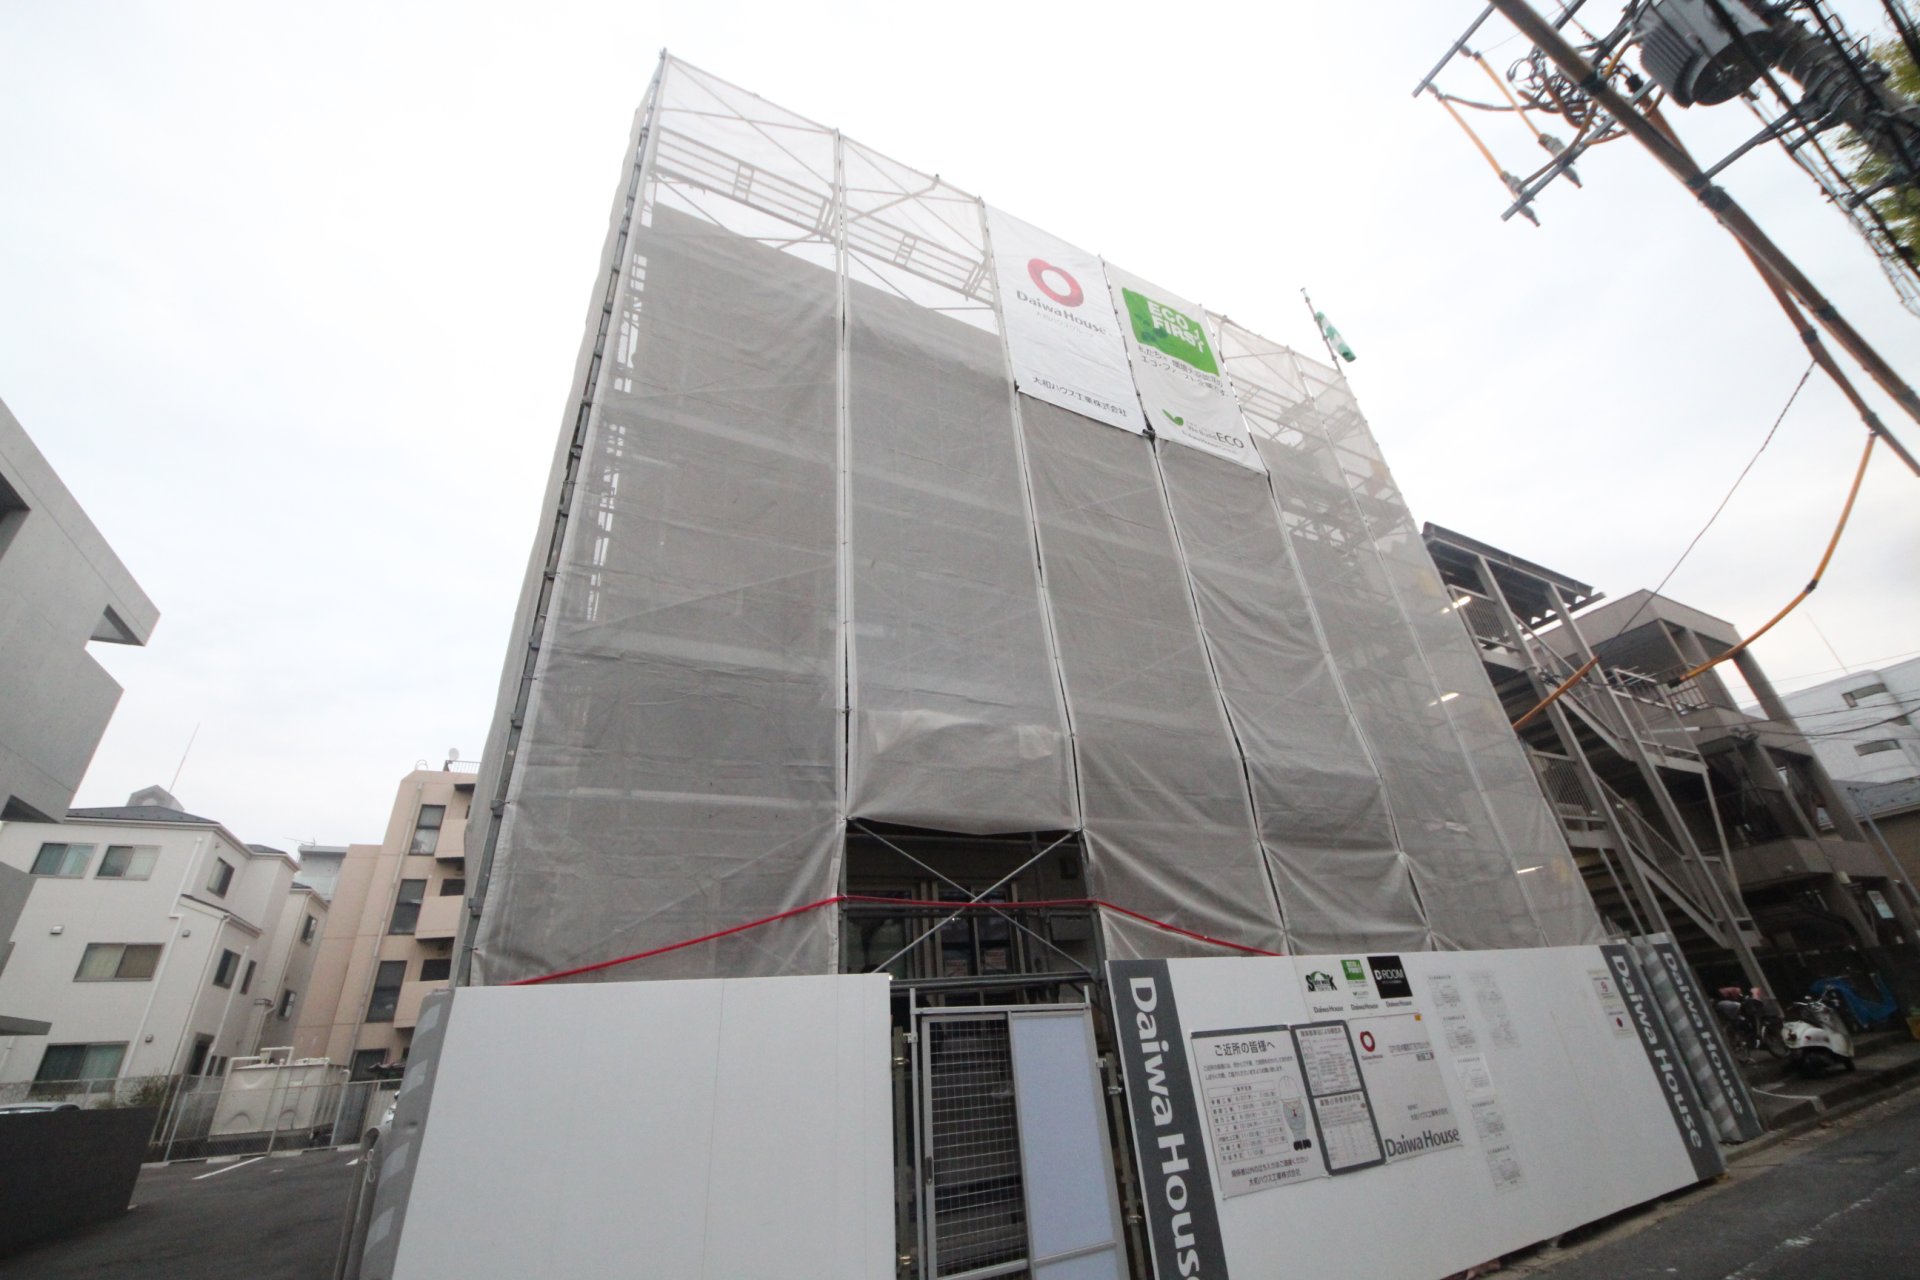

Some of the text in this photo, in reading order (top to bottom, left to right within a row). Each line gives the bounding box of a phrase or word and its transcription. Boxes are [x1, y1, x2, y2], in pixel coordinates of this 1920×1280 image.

[1016, 290, 1063, 316] Daiwa
[1063, 309, 1107, 335] House
[1147, 300, 1189, 330] ECO
[1152, 317, 1205, 353] FIRST
[1033, 376, 1127, 418] 大和ハウス工業株式会社
[1216, 431, 1245, 449] ECO
[1214, 1040, 1276, 1057] ご近所の皆様へ
[1613, 955, 1658, 1045] Daiwa
[1653, 1048, 1702, 1149] House
[1662, 952, 1744, 1116] Daiwa House
[1129, 977, 1200, 1280] Daiwa Hous
[1384, 1133, 1424, 1157] Daiwa
[1422, 1128, 1460, 1150] House
